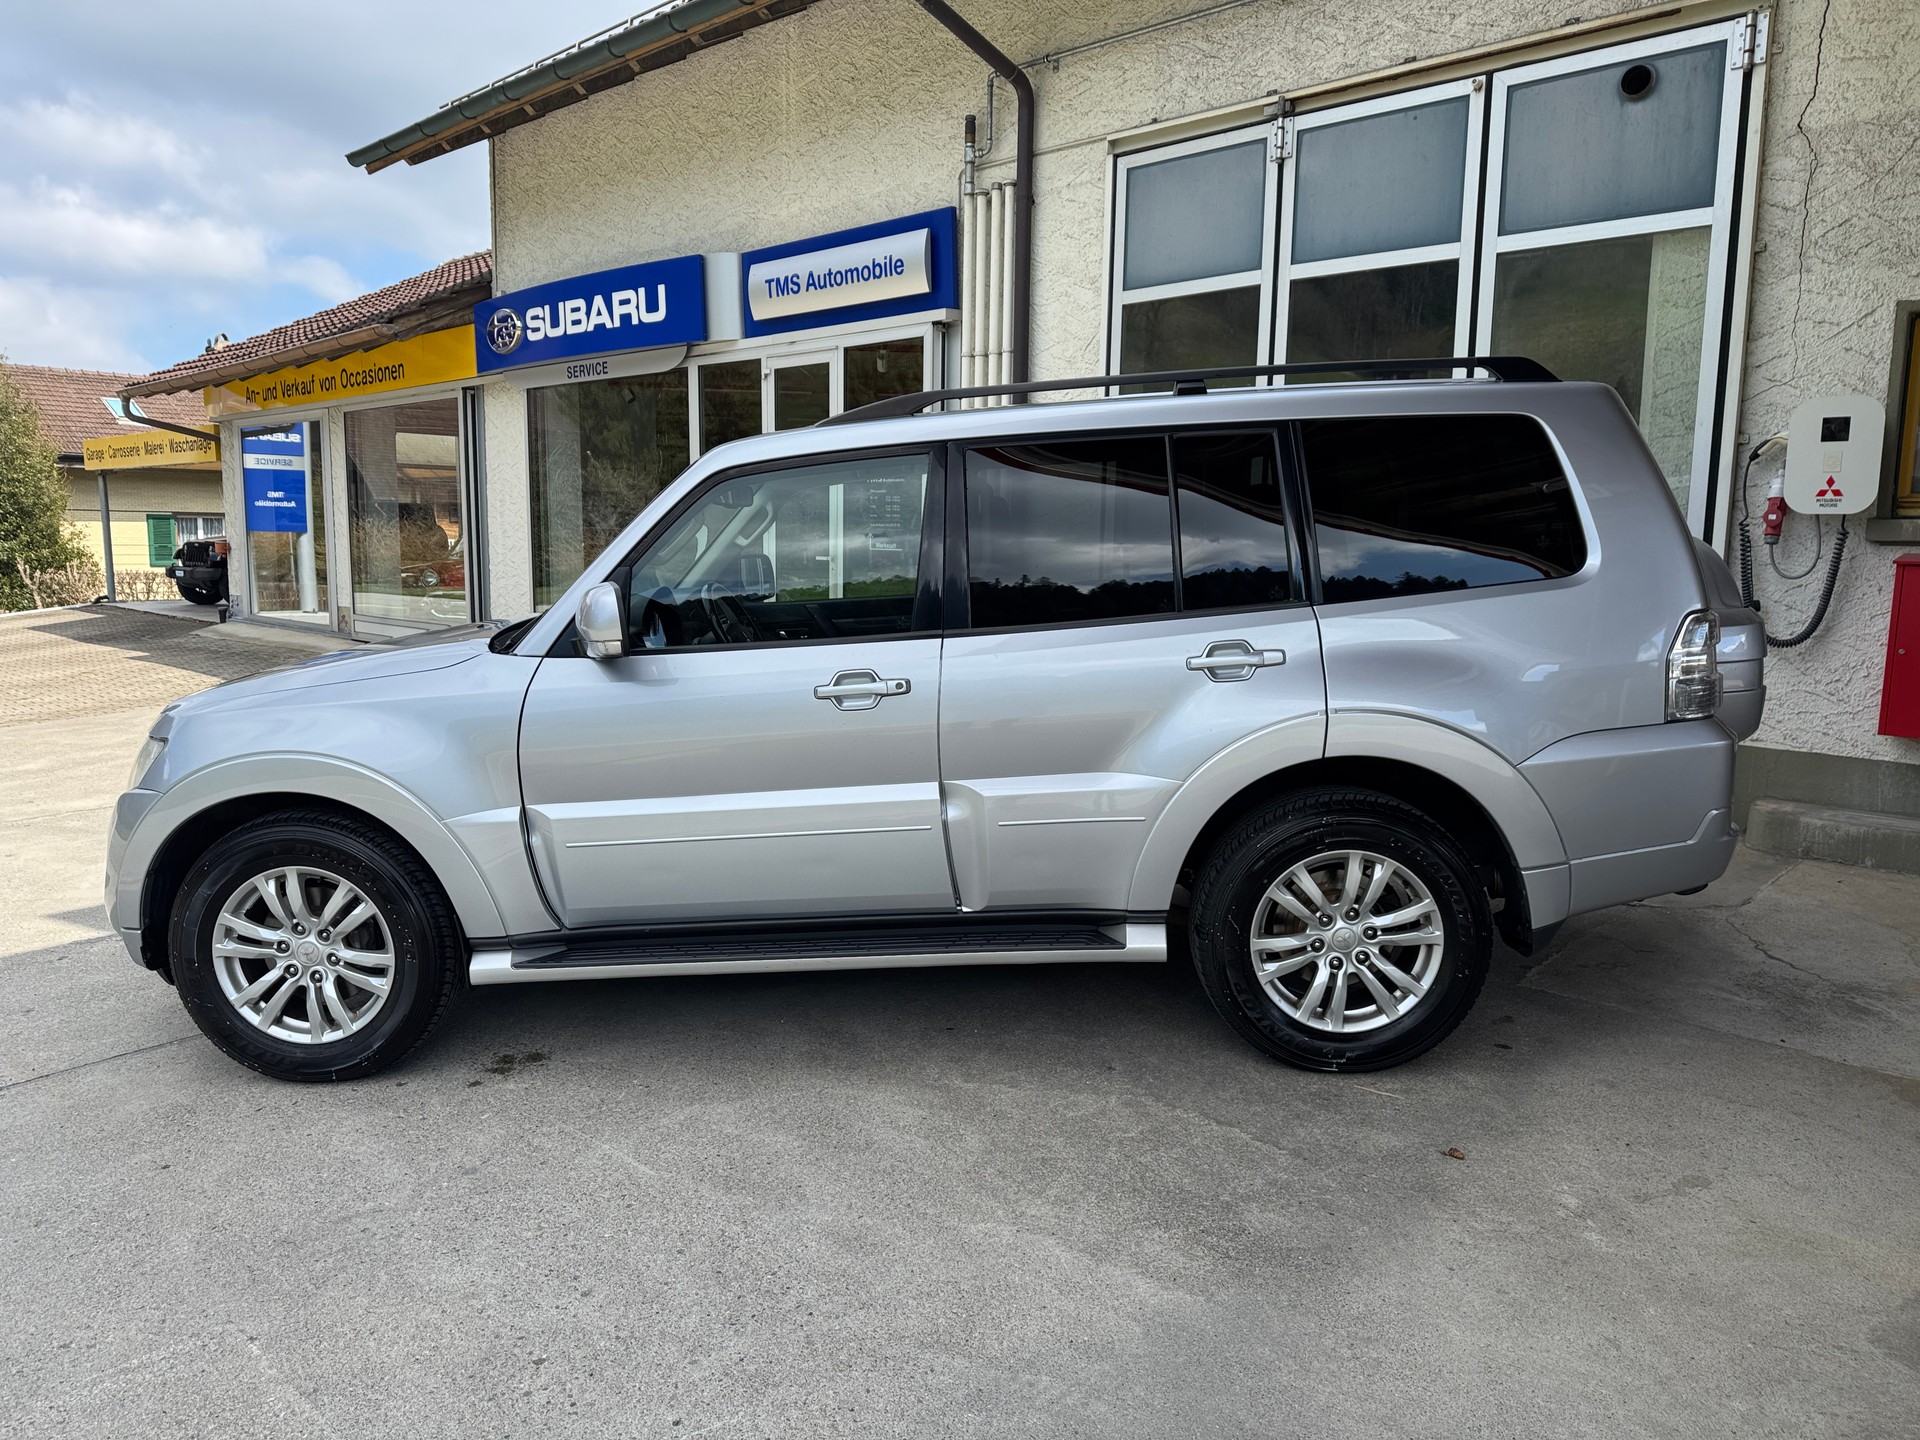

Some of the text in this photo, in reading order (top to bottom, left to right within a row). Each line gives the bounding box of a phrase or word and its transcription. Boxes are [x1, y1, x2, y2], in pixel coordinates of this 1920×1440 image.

[764, 254, 905, 299] TMS Automobile
[525, 283, 667, 342] SUBARU
[261, 381, 278, 402] und
[279, 374, 316, 398] Verkauf
[318, 375, 337, 392] von
[340, 362, 405, 389] Occasionen
[566, 361, 609, 379] SERVICE
[86, 437, 212, 462] Garage Carrosserie Malerei Waschanlage
